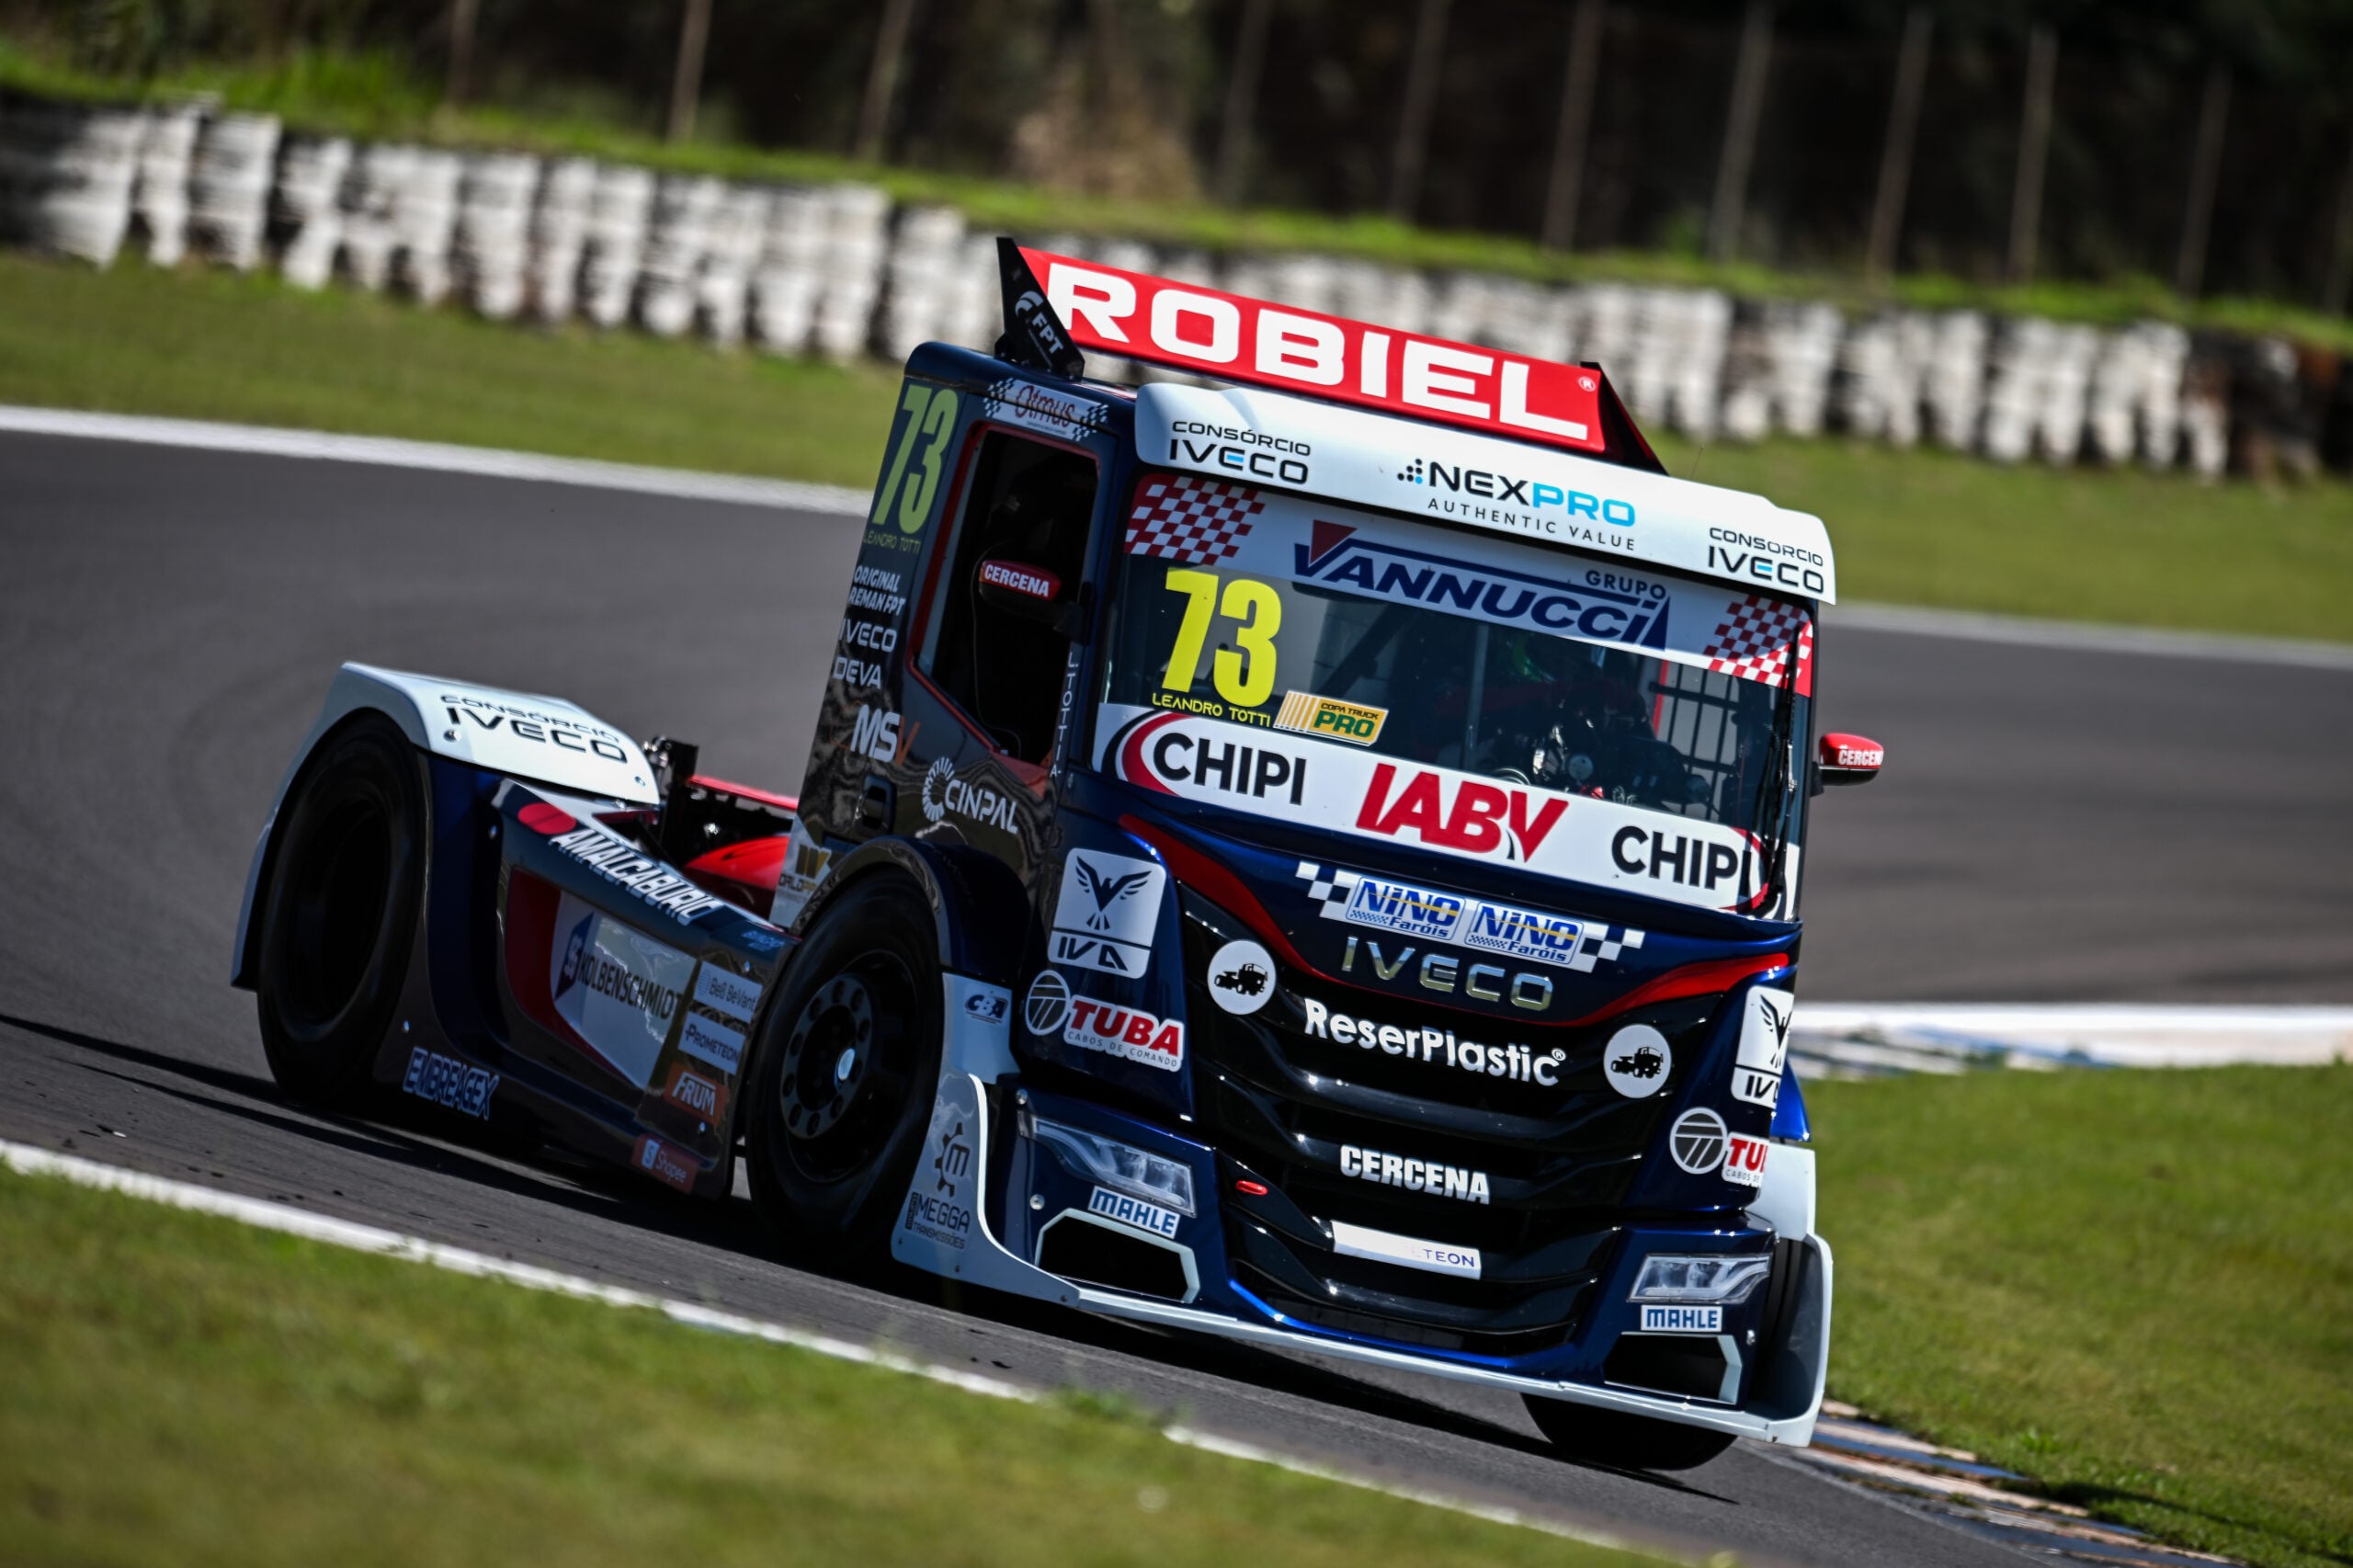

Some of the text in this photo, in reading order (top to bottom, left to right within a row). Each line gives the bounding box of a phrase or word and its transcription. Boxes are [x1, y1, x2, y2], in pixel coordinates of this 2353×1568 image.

[1031, 312, 1064, 354] FPT
[1047, 262, 1588, 441] ROBIEL
[872, 384, 958, 534] 73
[1169, 438, 1309, 485] IVECO
[1172, 421, 1311, 457] CONSÓRCIO
[1429, 460, 1636, 528] NEXPRO
[900, 537, 922, 553] TOTTI
[1428, 497, 1636, 551] AUTHENTIC VALUE
[853, 565, 901, 594] ORIGINAL
[983, 563, 1050, 597] CERCENA
[1586, 570, 1667, 601] GRUPO
[1708, 545, 1824, 594] IVECO
[849, 586, 905, 616] REMAN FPT
[838, 618, 898, 653] IVECO
[1161, 567, 1281, 708] 73
[832, 656, 882, 689] DEVA
[1056, 673, 1077, 761] TOTTI
[1152, 694, 1271, 728] LEANDRO TOTTI
[1313, 710, 1376, 738] PRO
[1321, 702, 1379, 721] COPA TRUCK
[446, 707, 629, 764] IVECO
[1153, 732, 1307, 807] CHIPI
[944, 779, 1019, 835] CINPAL
[549, 828, 725, 925] AMALCABURIO
[1611, 825, 1753, 899] CHIPI
[1056, 936, 1129, 971] IVA
[1341, 936, 1555, 1012] IVECO
[578, 952, 682, 1021] KOLBENSCHMIDT
[1067, 1031, 1177, 1068] CABOS DE COMANDO
[1070, 999, 1180, 1057] TUBA
[672, 1072, 716, 1117] FRUM
[654, 1149, 688, 1184] Shopee
[1340, 1144, 1491, 1205] CERCENA
[1728, 1137, 1769, 1174] TU
[915, 1193, 971, 1234] MEGGA
[1092, 1188, 1176, 1235] MAHLE
[1646, 1308, 1719, 1329] MAHLE
